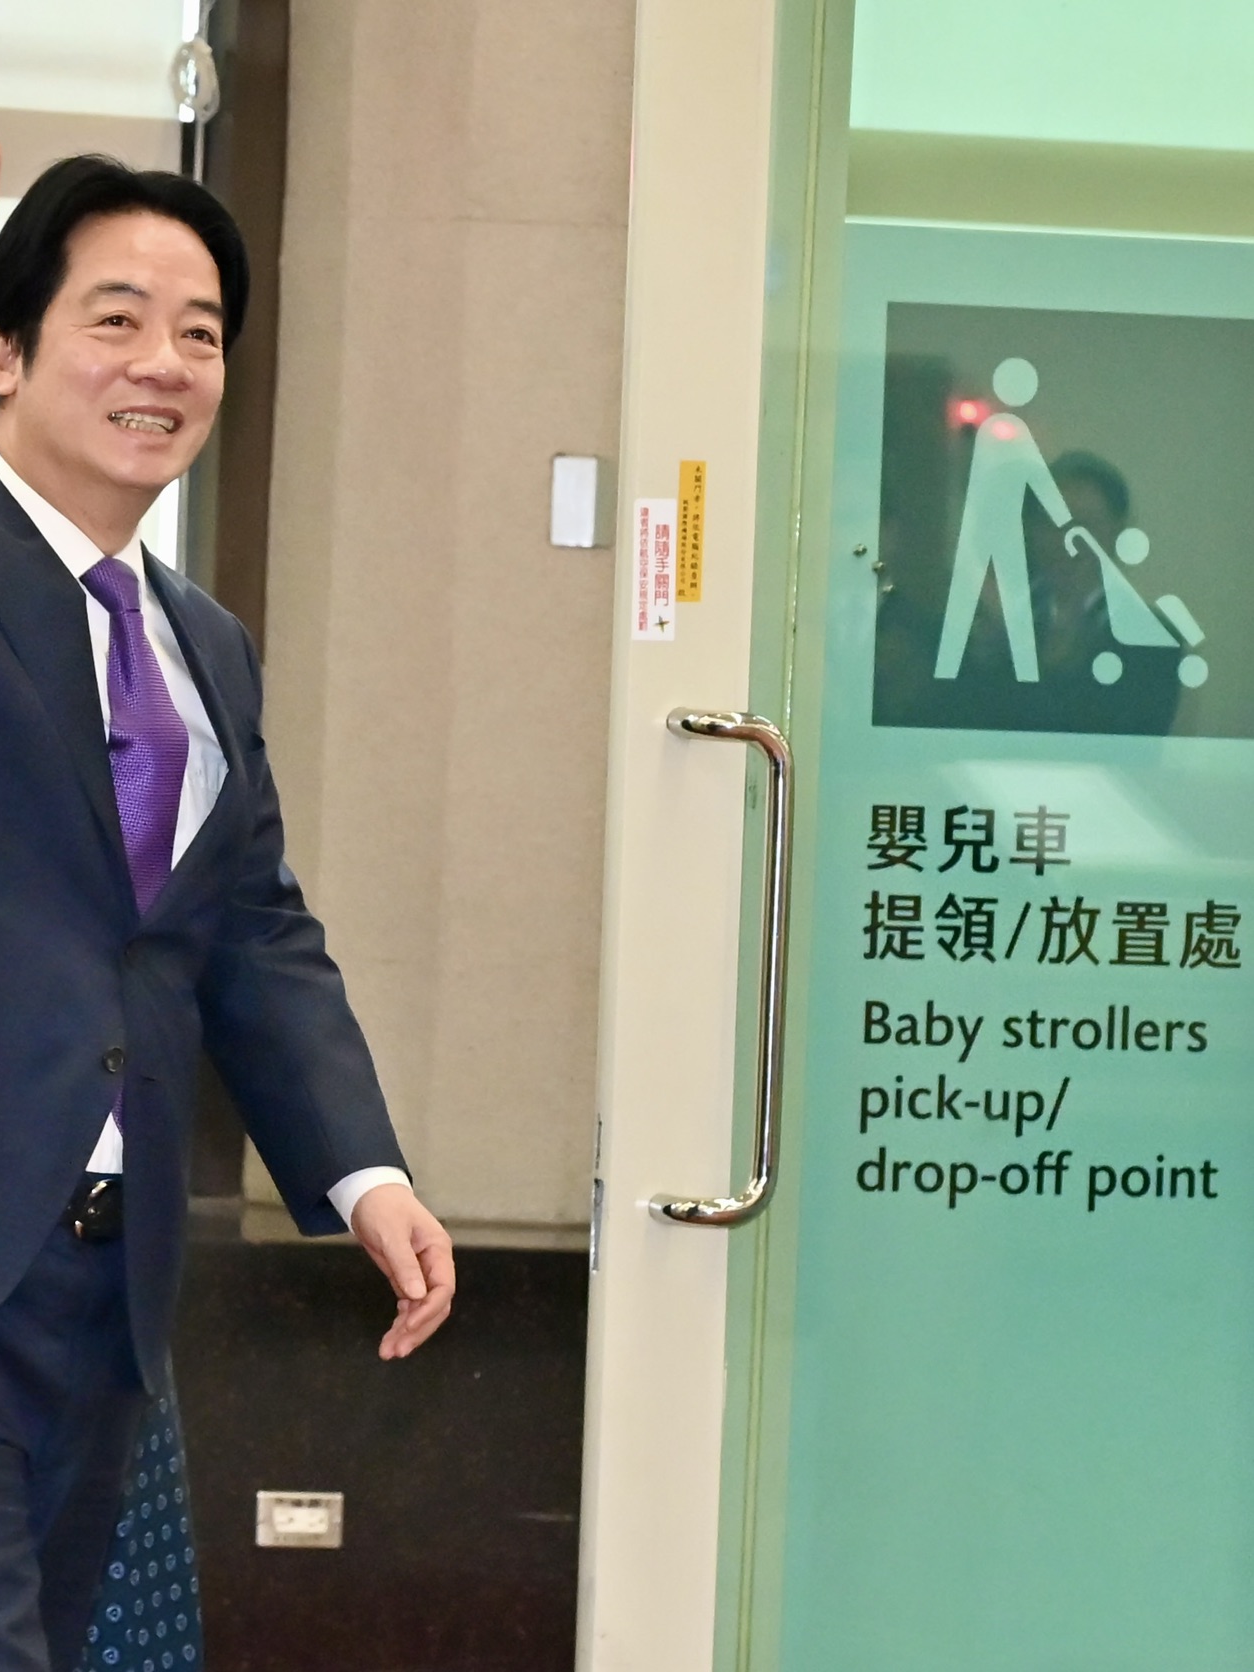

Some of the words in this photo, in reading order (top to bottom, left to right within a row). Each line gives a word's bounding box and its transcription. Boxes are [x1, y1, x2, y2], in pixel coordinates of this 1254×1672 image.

[654, 524, 670, 607] 請隨手關門
[866, 804, 1071, 876] 嬰兒車
[862, 890, 1242, 969] 提領/放置處
[863, 1000, 984, 1063] Baby
[1002, 1004, 1208, 1053] strollers
[859, 1074, 1070, 1137] pick-up/
[856, 1146, 1073, 1210] drop-off
[1087, 1153, 1219, 1212] point
